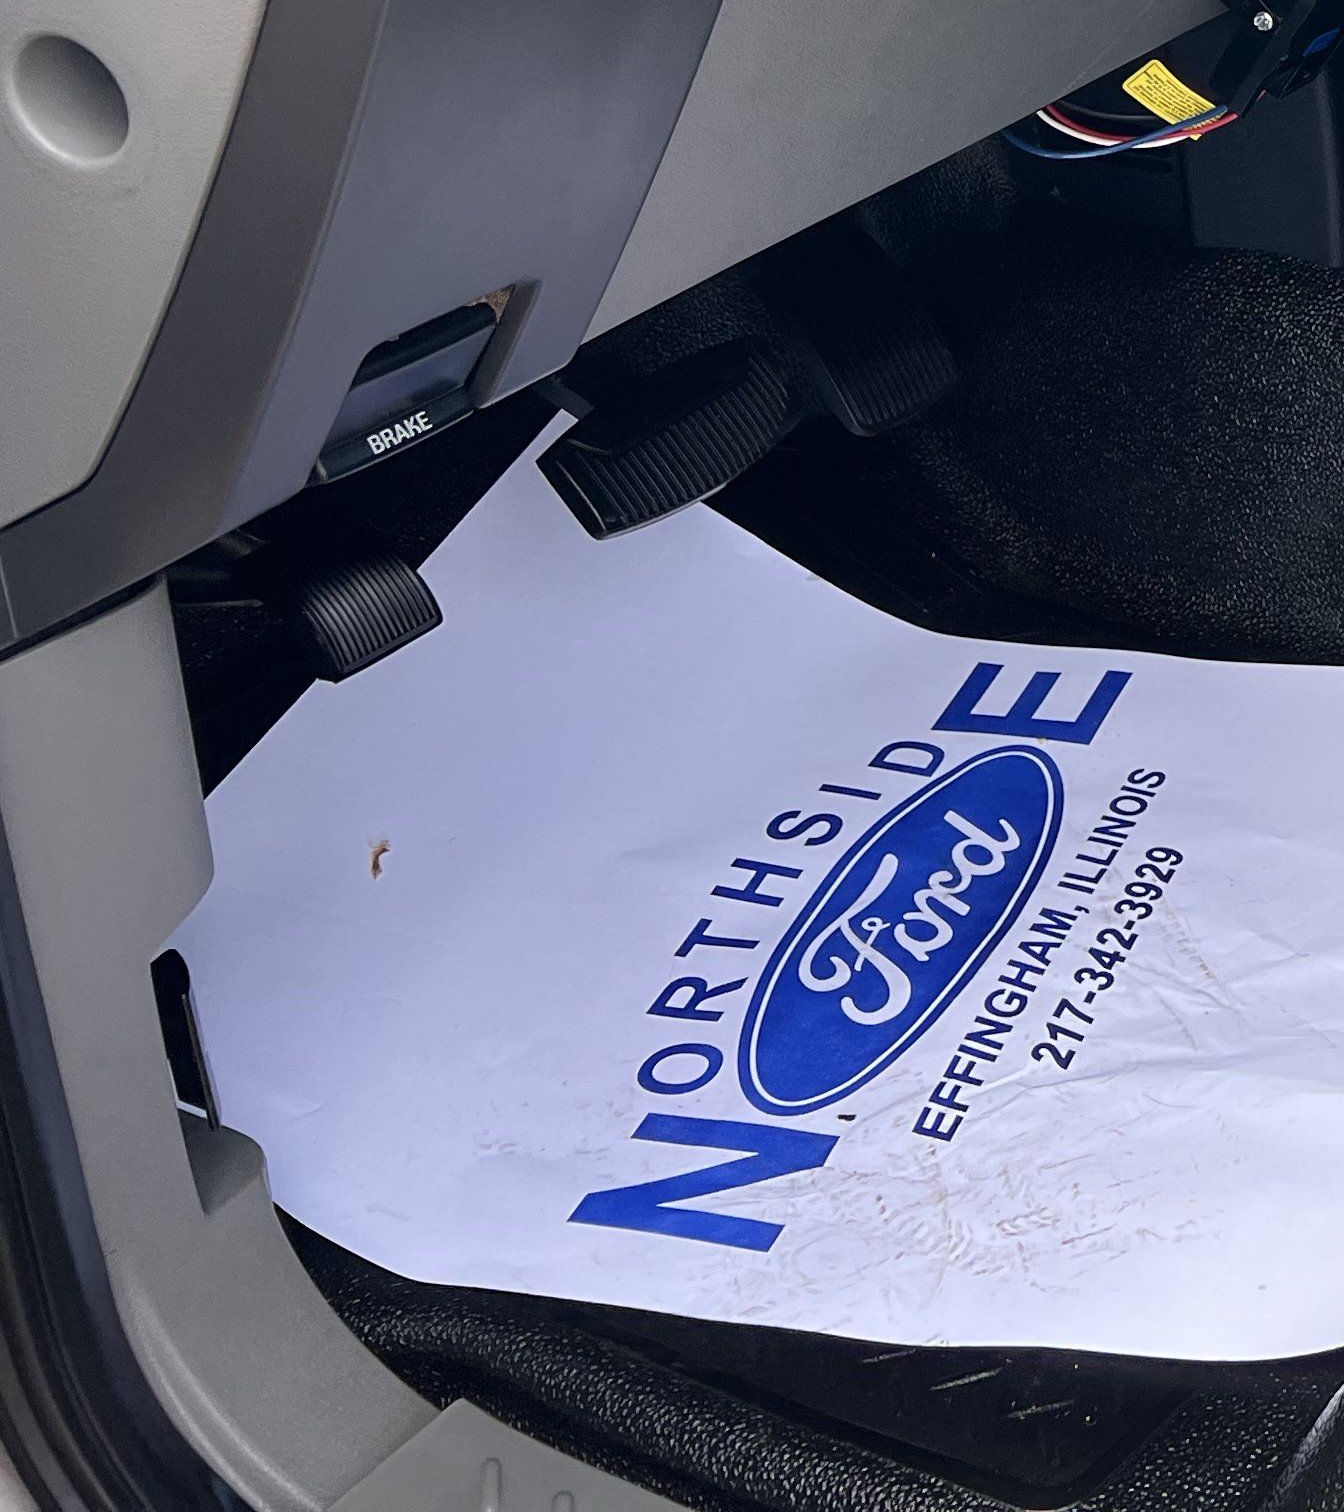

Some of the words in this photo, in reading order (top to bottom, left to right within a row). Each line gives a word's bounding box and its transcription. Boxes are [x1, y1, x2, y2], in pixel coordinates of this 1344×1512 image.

[366, 410, 433, 456] BRAKE
[567, 662, 1133, 1252] NORTHSIDE
[799, 809, 1021, 1026] Ford
[912, 905, 1090, 1143] EFFINGHAM,
[1057, 767, 1166, 895] ILLINOIS
[1030, 846, 1184, 1070] 217-342-3929
